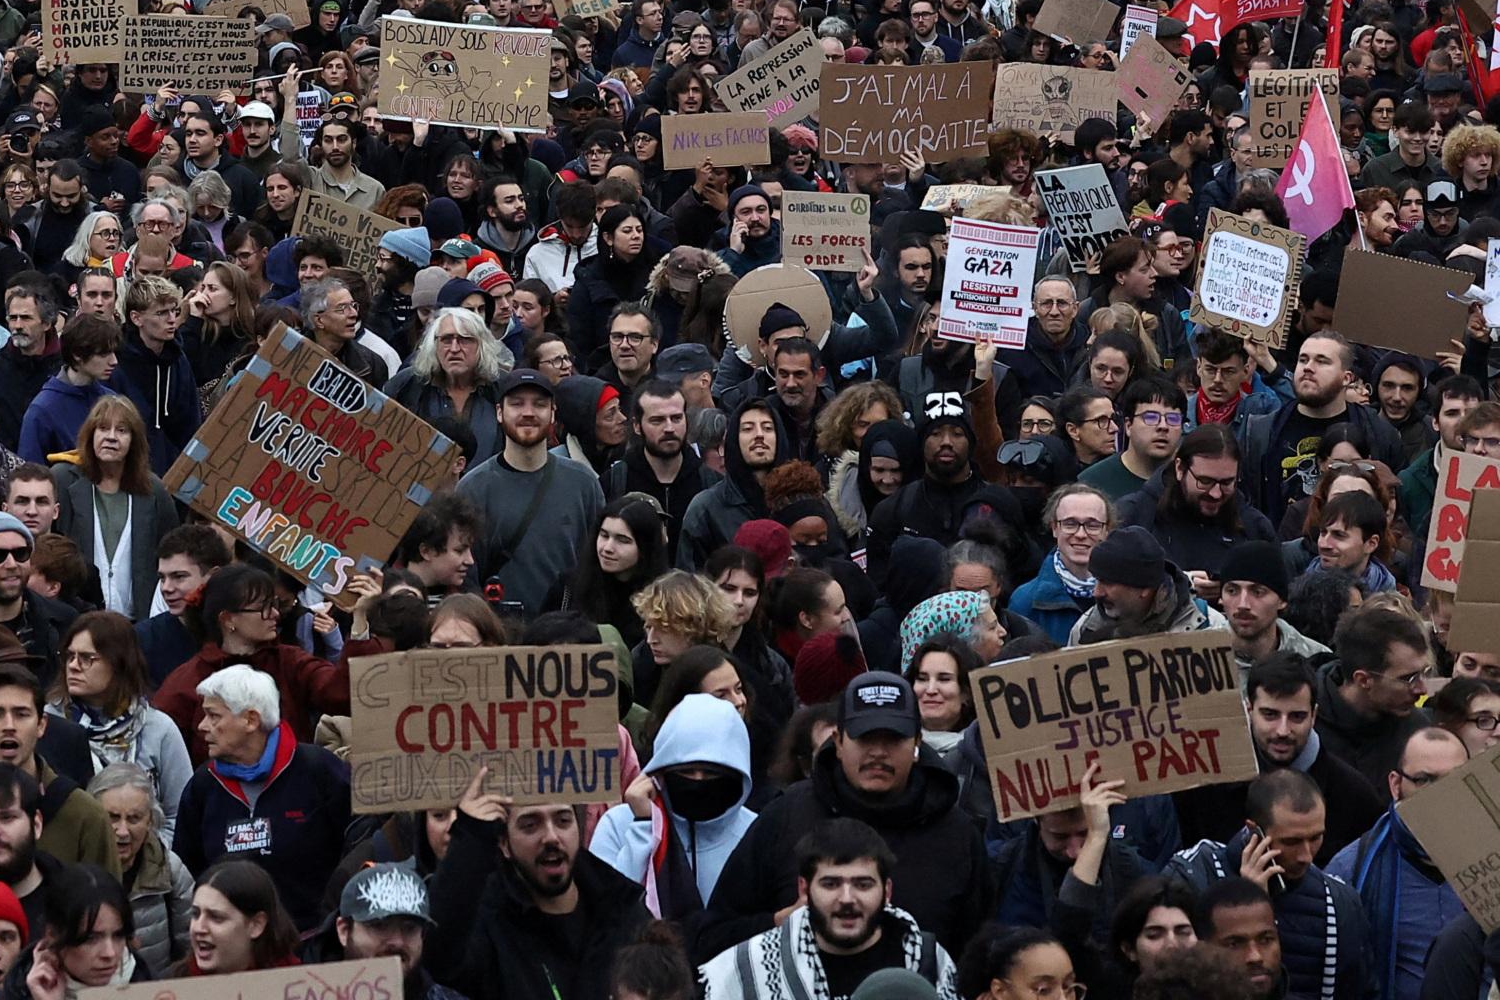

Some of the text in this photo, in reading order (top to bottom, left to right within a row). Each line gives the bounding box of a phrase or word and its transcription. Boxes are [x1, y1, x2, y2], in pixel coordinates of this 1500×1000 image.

[51, 5, 124, 22] CRAPULES
[125, 21, 137, 31] LA
[197, 21, 224, 34] C'EST
[226, 24, 251, 35] NOUS
[51, 34, 119, 49] ORDURES
[125, 32, 137, 43] LA
[192, 32, 220, 43] C'EST
[223, 35, 247, 44] NOUS
[459, 28, 487, 51] SOUS
[125, 43, 137, 53] LA
[125, 52, 248, 66] LA C'EST VOUS
[197, 65, 253, 78] C'EST VOUS
[787, 63, 806, 81] LA
[124, 79, 144, 90] LES
[725, 78, 746, 99] LA
[832, 73, 896, 106] J'AI
[900, 73, 948, 104] MAL
[893, 106, 924, 123] MA
[1266, 101, 1286, 118] ET
[673, 127, 767, 151] NIK LES FACHOS
[824, 118, 987, 158] DÉMOCRATIE
[1257, 144, 1279, 158] LES
[1038, 174, 1065, 192] LA
[1054, 212, 1093, 235] C'EST
[791, 233, 866, 248] LES FORCES
[803, 254, 845, 267] ORDRE
[963, 257, 1013, 279] GAZA
[953, 290, 998, 304] ANTISIONISTE
[957, 301, 1022, 317] ANTICOLONIALISTE
[1214, 295, 1261, 320] Victor Hugo
[266, 332, 323, 385] UNE
[359, 396, 432, 455] DANS
[250, 368, 398, 475] MACHOIRE
[205, 432, 372, 553] LA BOUCHE
[220, 486, 354, 596] ENFANTS
[356, 650, 617, 710] C'EST NOUS
[1126, 645, 1234, 701] PARTOUT
[395, 699, 587, 755] CONTRE
[1055, 701, 1186, 751] JUSTICE
[353, 757, 448, 806] CEUX
[537, 748, 619, 795] HAUT
[996, 729, 1221, 818] NULLE PART
[228, 823, 237, 834] LE
[238, 831, 267, 842] PAS LES
